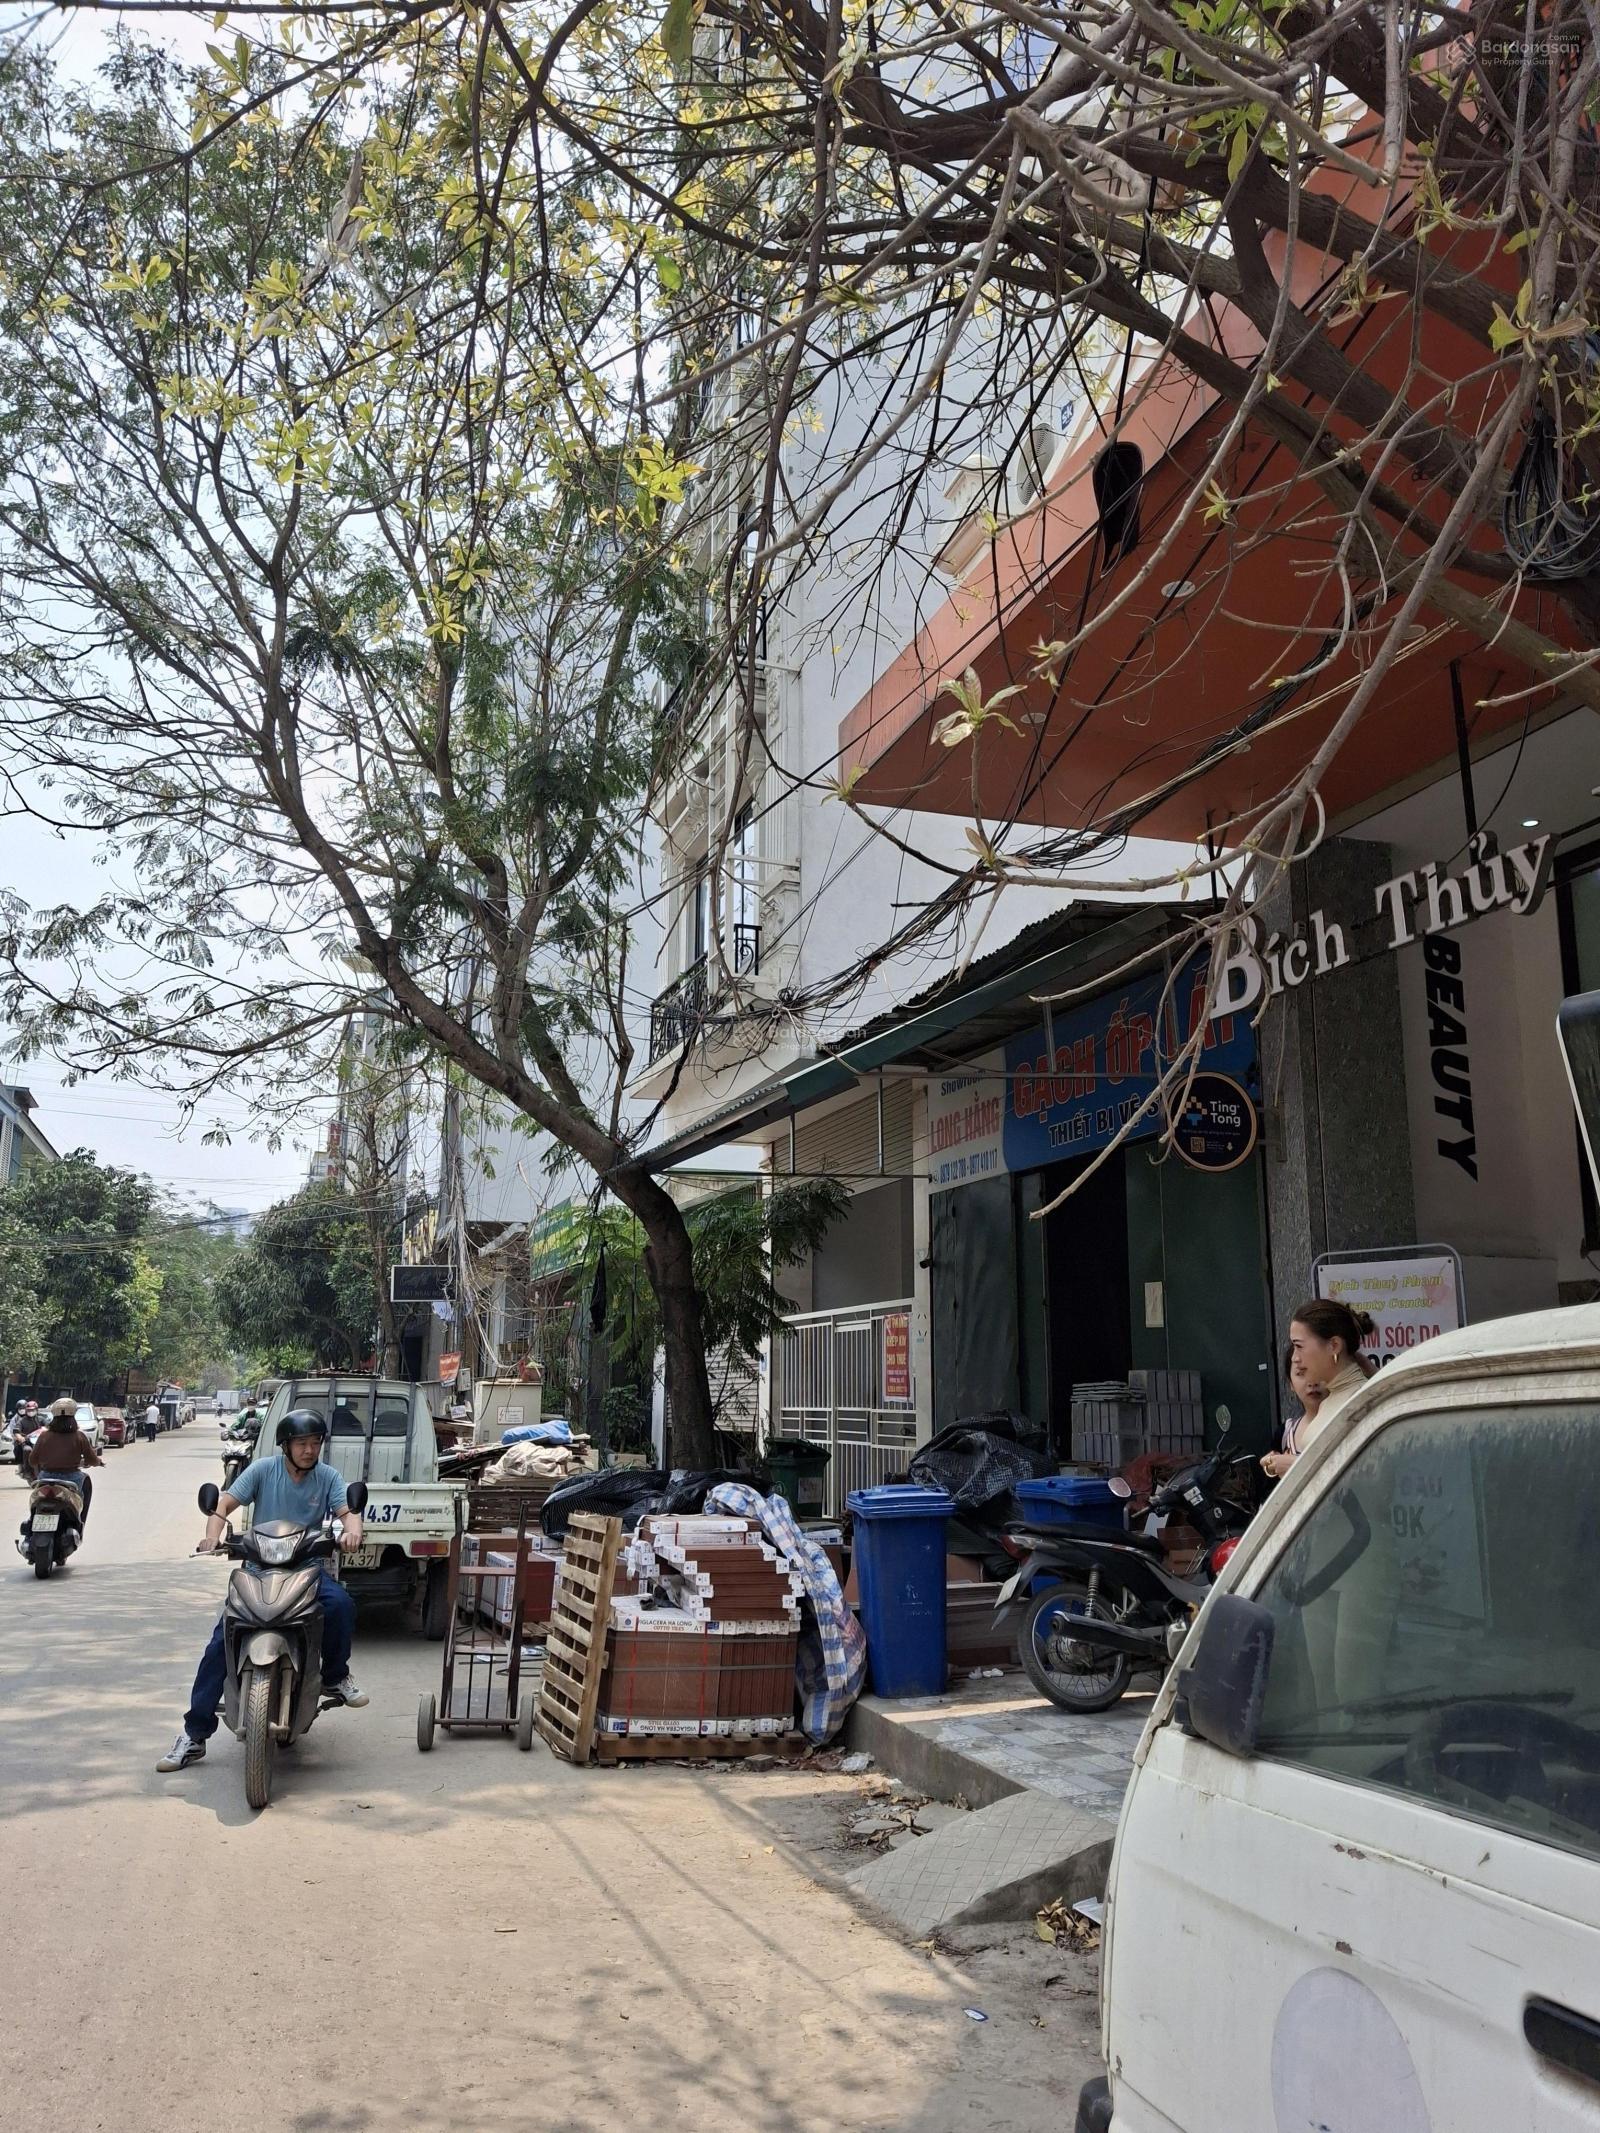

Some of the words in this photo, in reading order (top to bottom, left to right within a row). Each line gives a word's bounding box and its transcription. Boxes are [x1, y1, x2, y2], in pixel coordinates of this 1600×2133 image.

[1207, 909, 1351, 1020] Bích
[1374, 831, 1552, 949] Thủy
[1014, 1034, 1095, 1123] GẠCH
[1423, 934, 1478, 1183] BEAUTY
[1049, 1108, 1092, 1148] THIẾT
[1096, 1105, 1114, 1136] BỊ
[1209, 1100, 1237, 1115] Ting
[1210, 1112, 1241, 1127] Tong
[931, 1111, 961, 1154] LONG
[1385, 1322, 1415, 1349] SÓC
